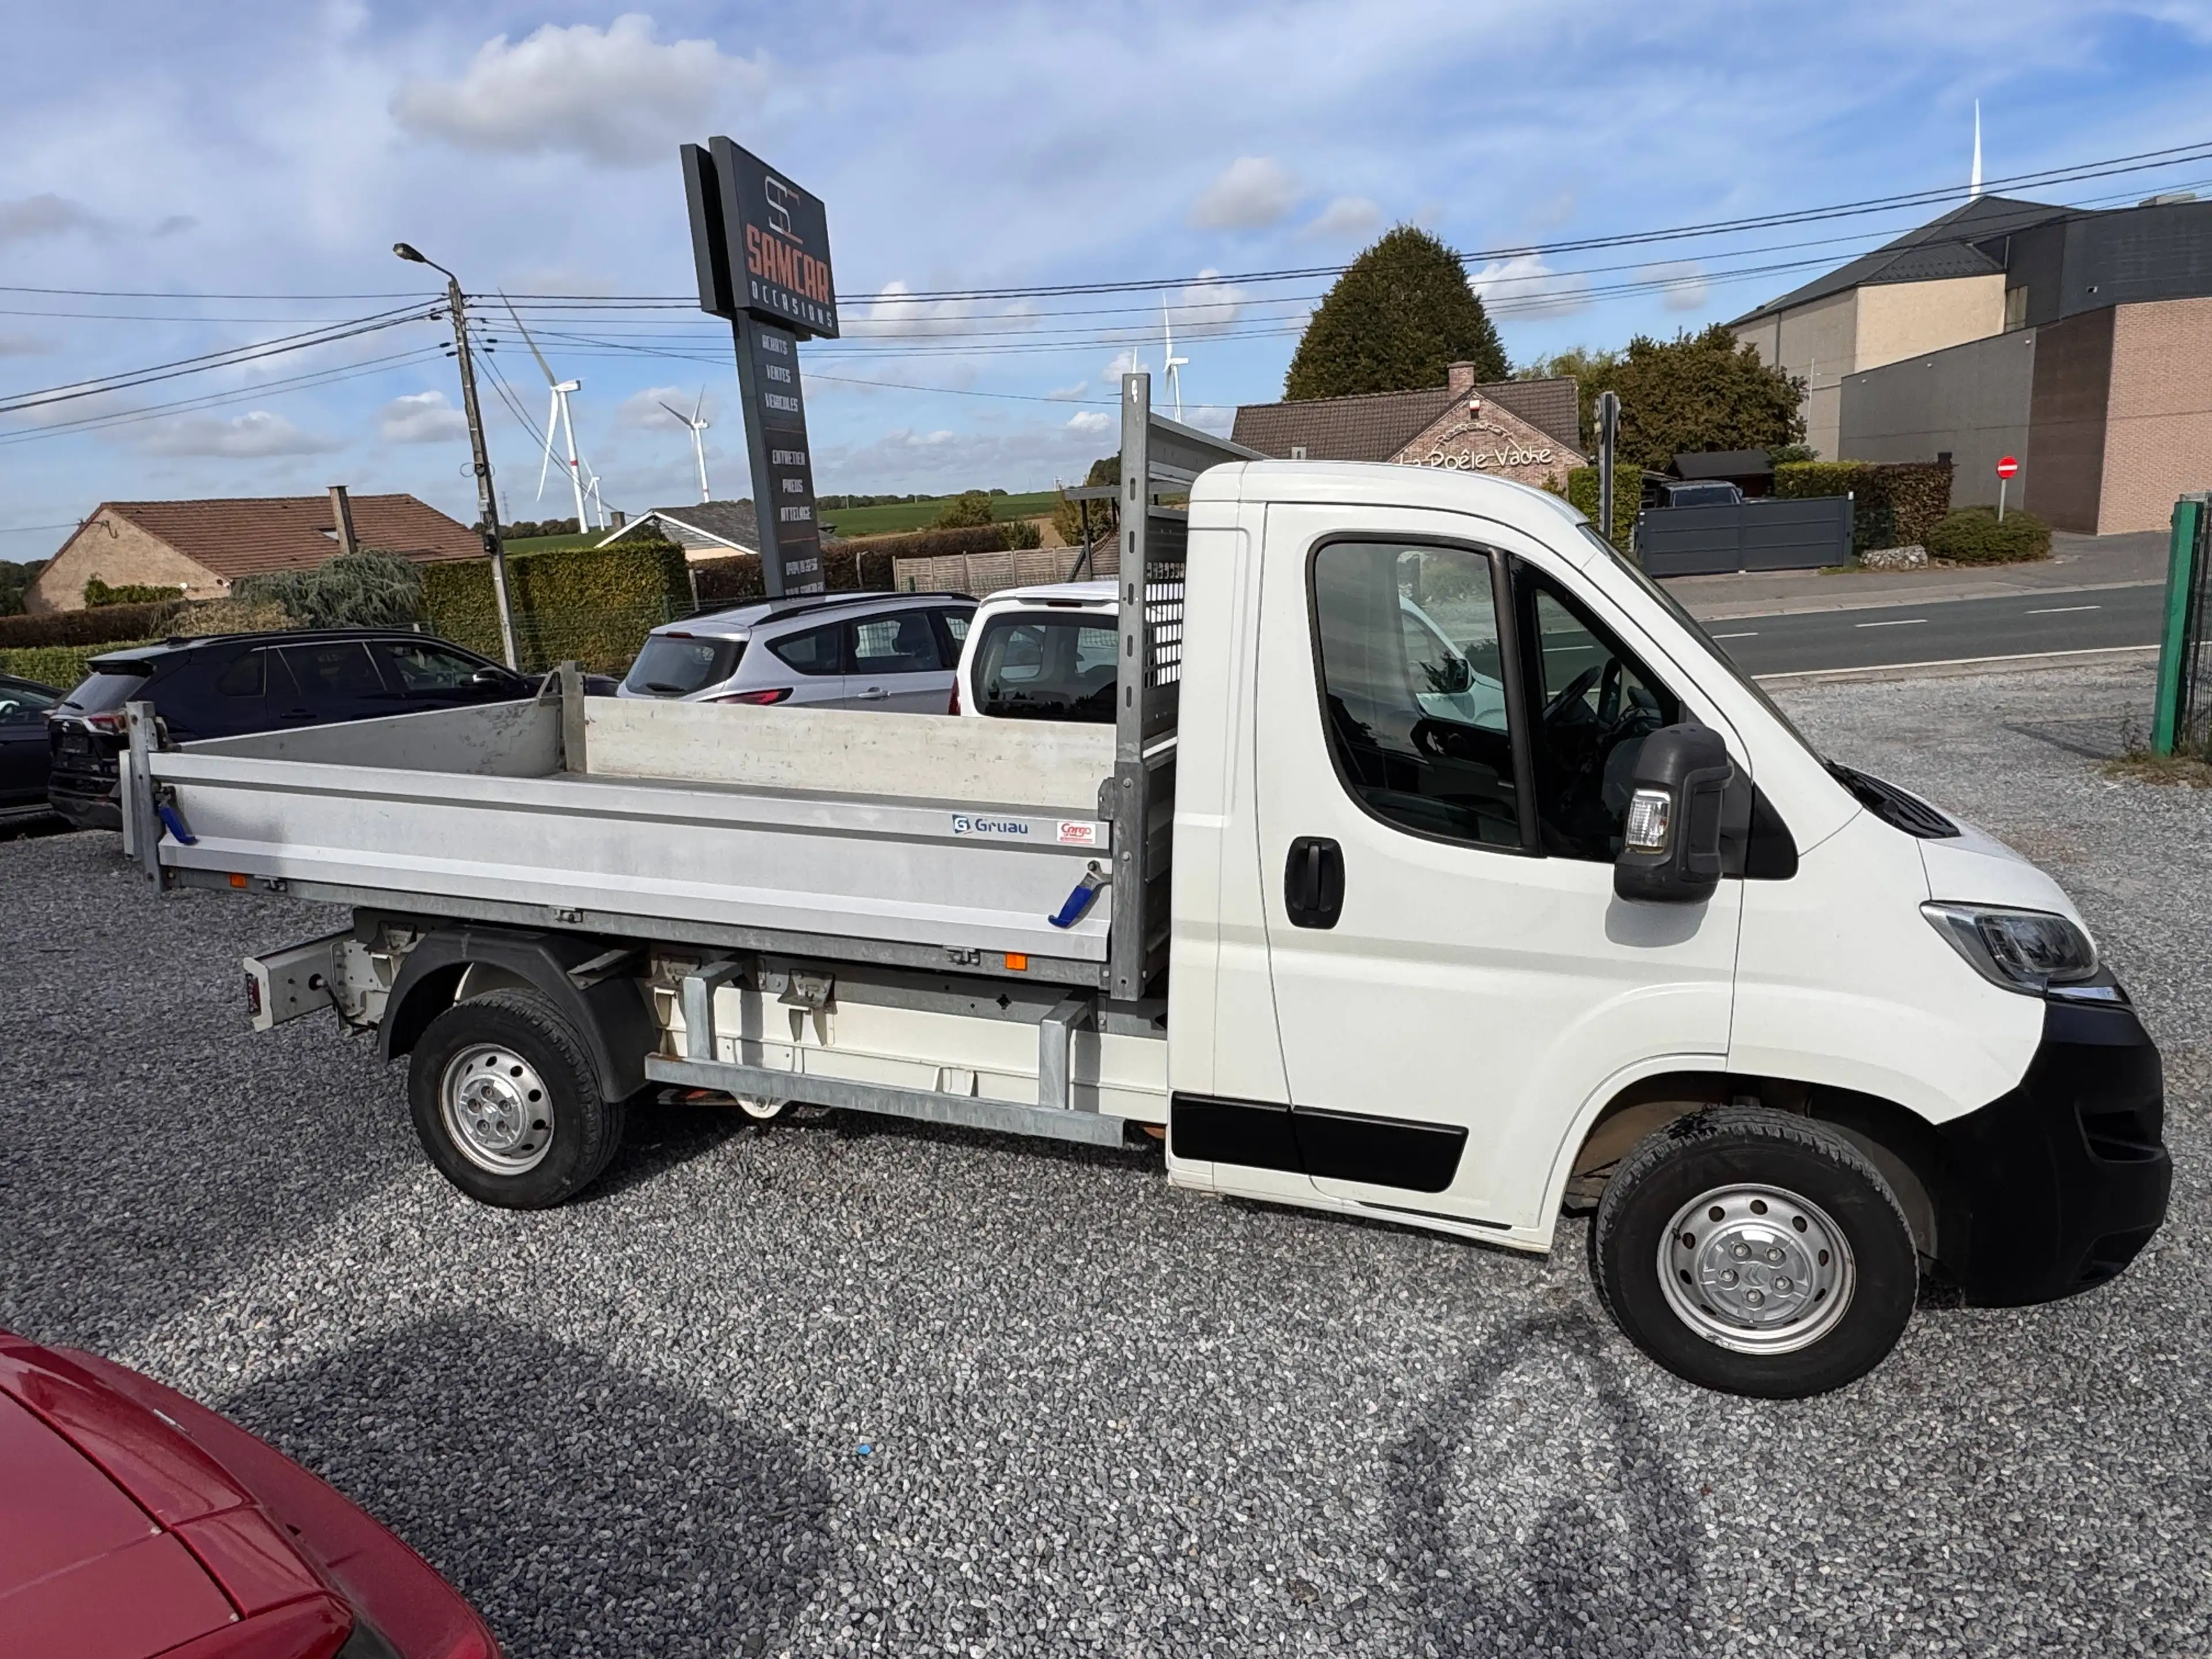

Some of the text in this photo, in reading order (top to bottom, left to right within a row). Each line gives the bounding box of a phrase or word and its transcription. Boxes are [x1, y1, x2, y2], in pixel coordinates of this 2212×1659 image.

[747, 224, 830, 305] SAMCAR
[751, 281, 833, 328] OCCASIONS
[766, 364, 791, 383] VENTES
[772, 449, 805, 466] ENTRETIEN
[1431, 448, 1487, 469] Poêle
[1494, 445, 1553, 468] Vache
[975, 819, 1028, 834] Gruau
